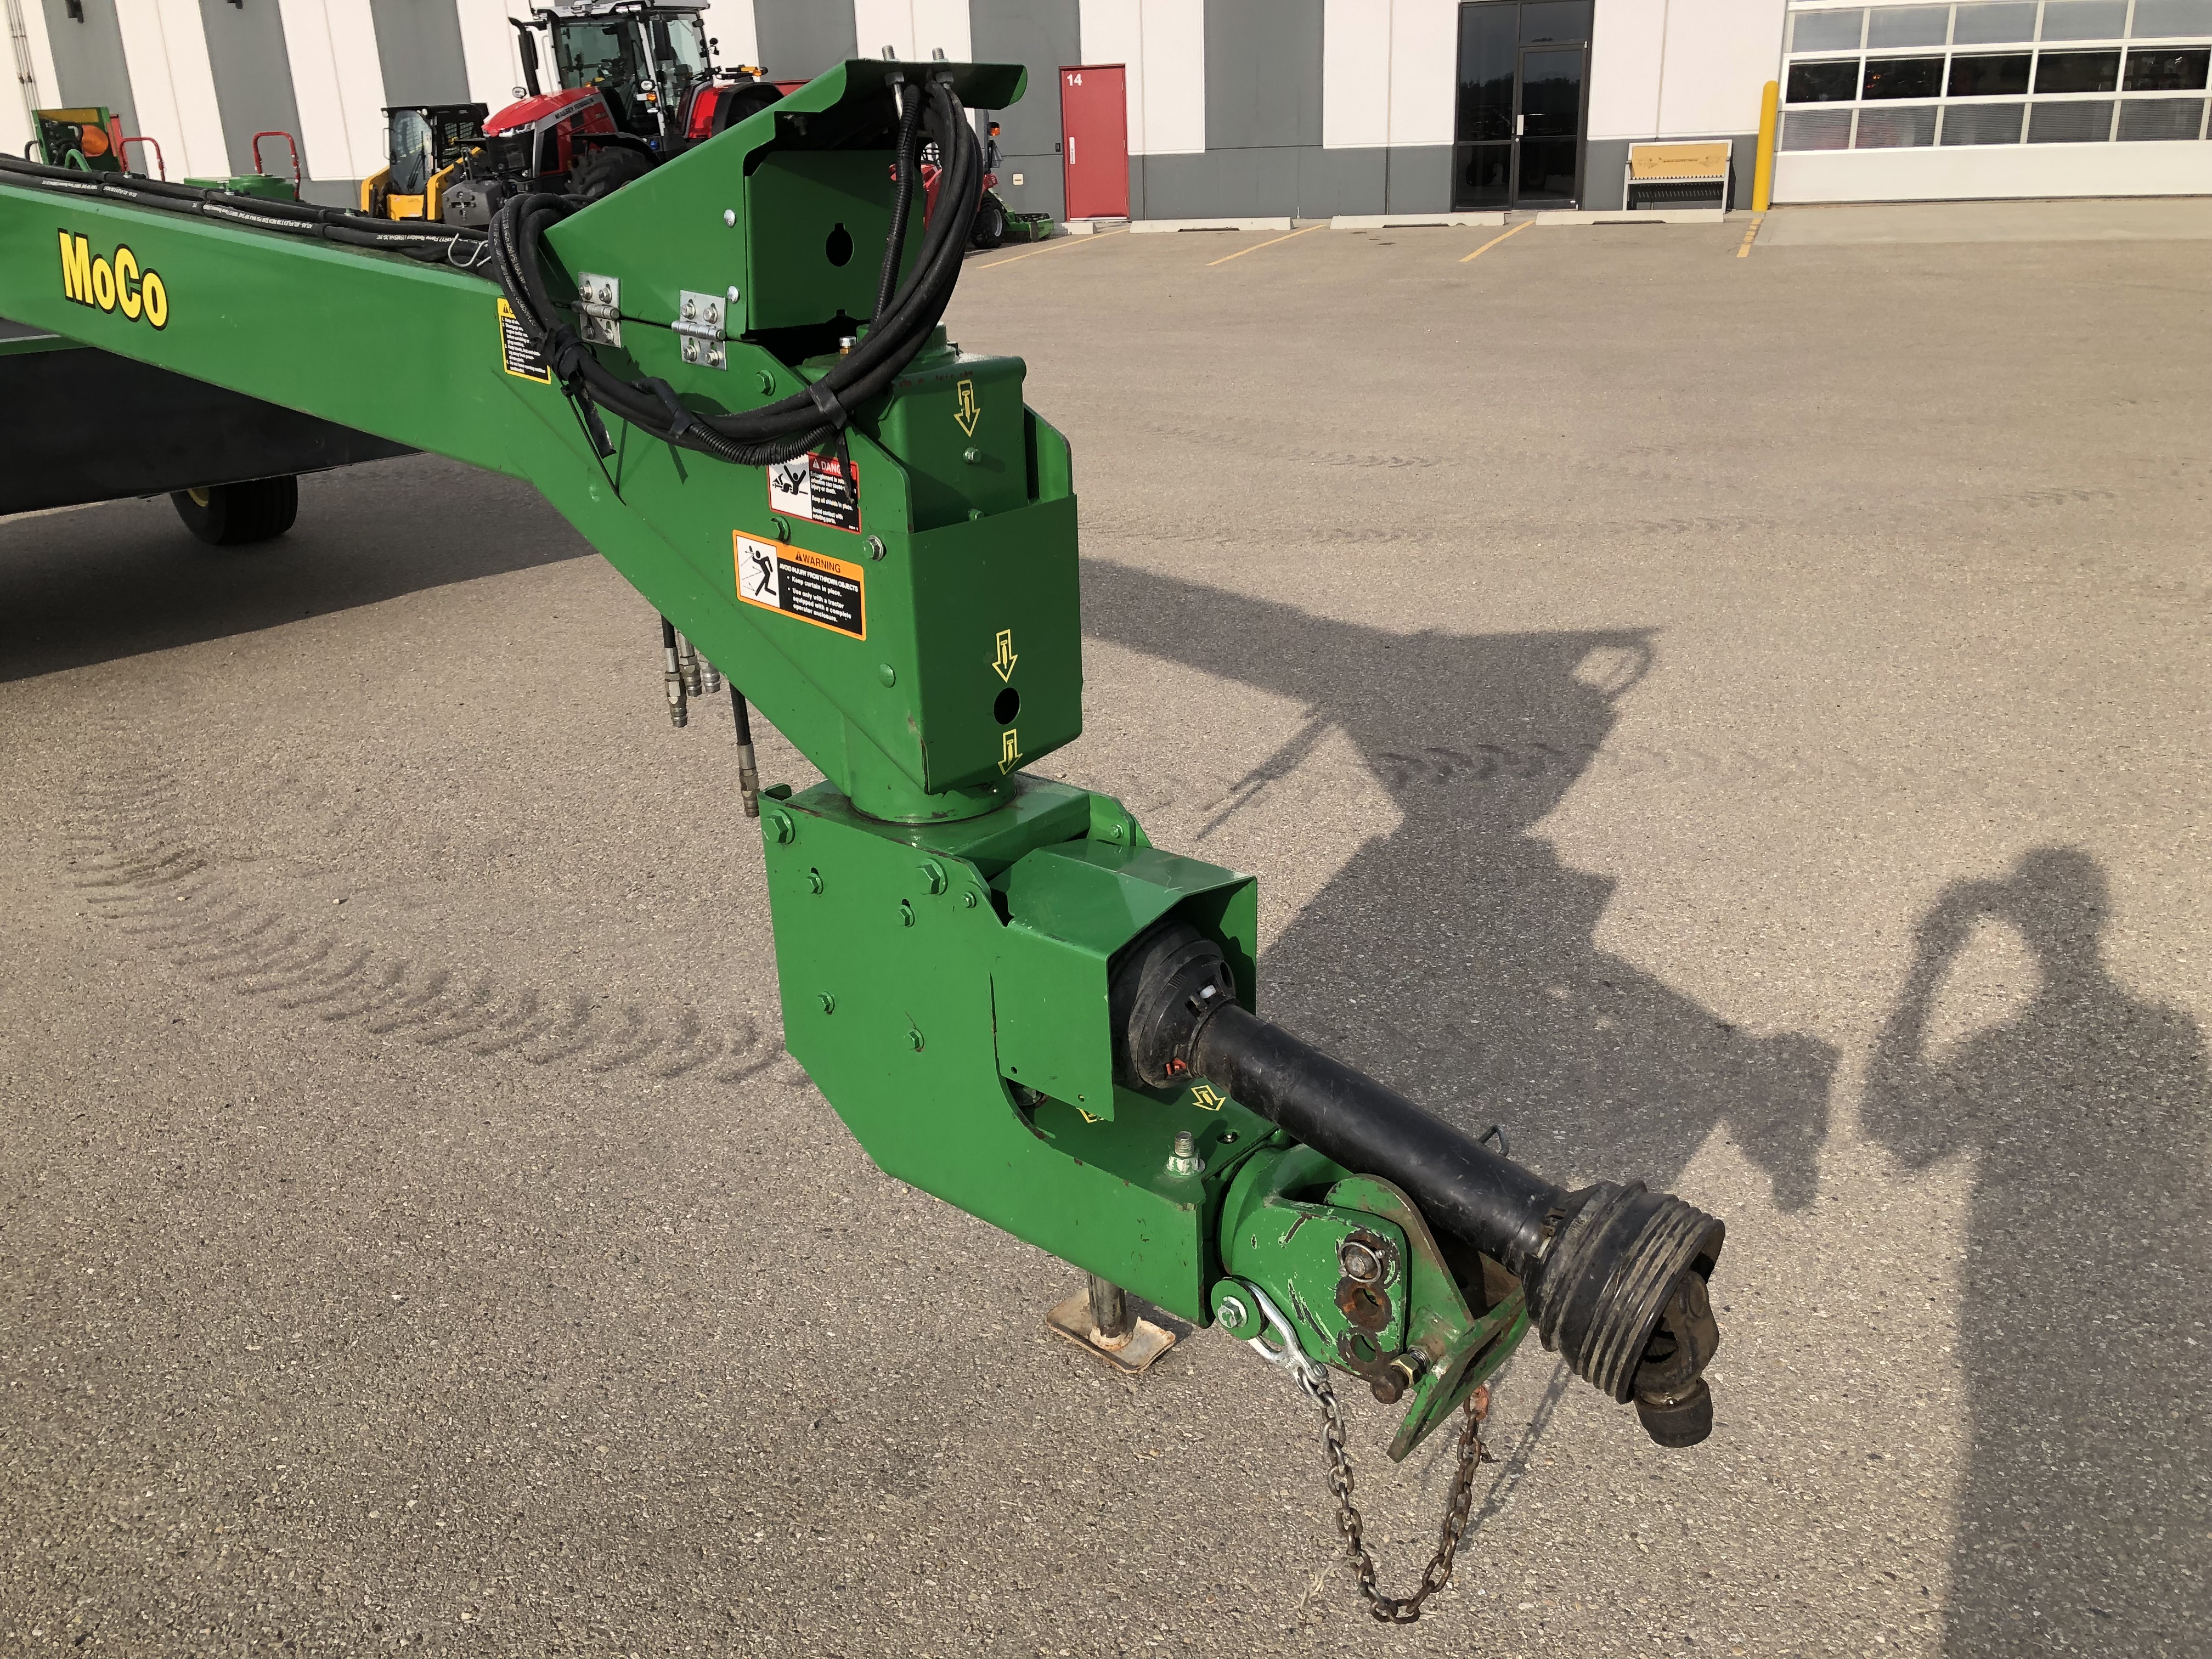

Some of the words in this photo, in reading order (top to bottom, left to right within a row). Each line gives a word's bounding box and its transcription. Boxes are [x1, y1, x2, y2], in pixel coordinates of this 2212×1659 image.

[1066, 73, 1082, 86] 14
[58, 228, 169, 331] MoCo
[803, 554, 841, 574] WARNING
[779, 563, 792, 572] AVOID
[792, 567, 807, 577] INJURY
[807, 571, 820, 580] FROM
[819, 574, 838, 586] THROWN
[838, 580, 859, 592] OBJECTS
[792, 576, 804, 586] Keep
[804, 580, 821, 591] curtain
[827, 588, 842, 597] place.
[792, 587, 802, 596] Use
[802, 591, 812, 600] only
[812, 594, 823, 603] with
[828, 599, 844, 610] tractor
[792, 596, 814, 607] equipped
[830, 607, 851, 619] complete
[793, 603, 813, 614] operator
[813, 610, 838, 623] enclosure.
